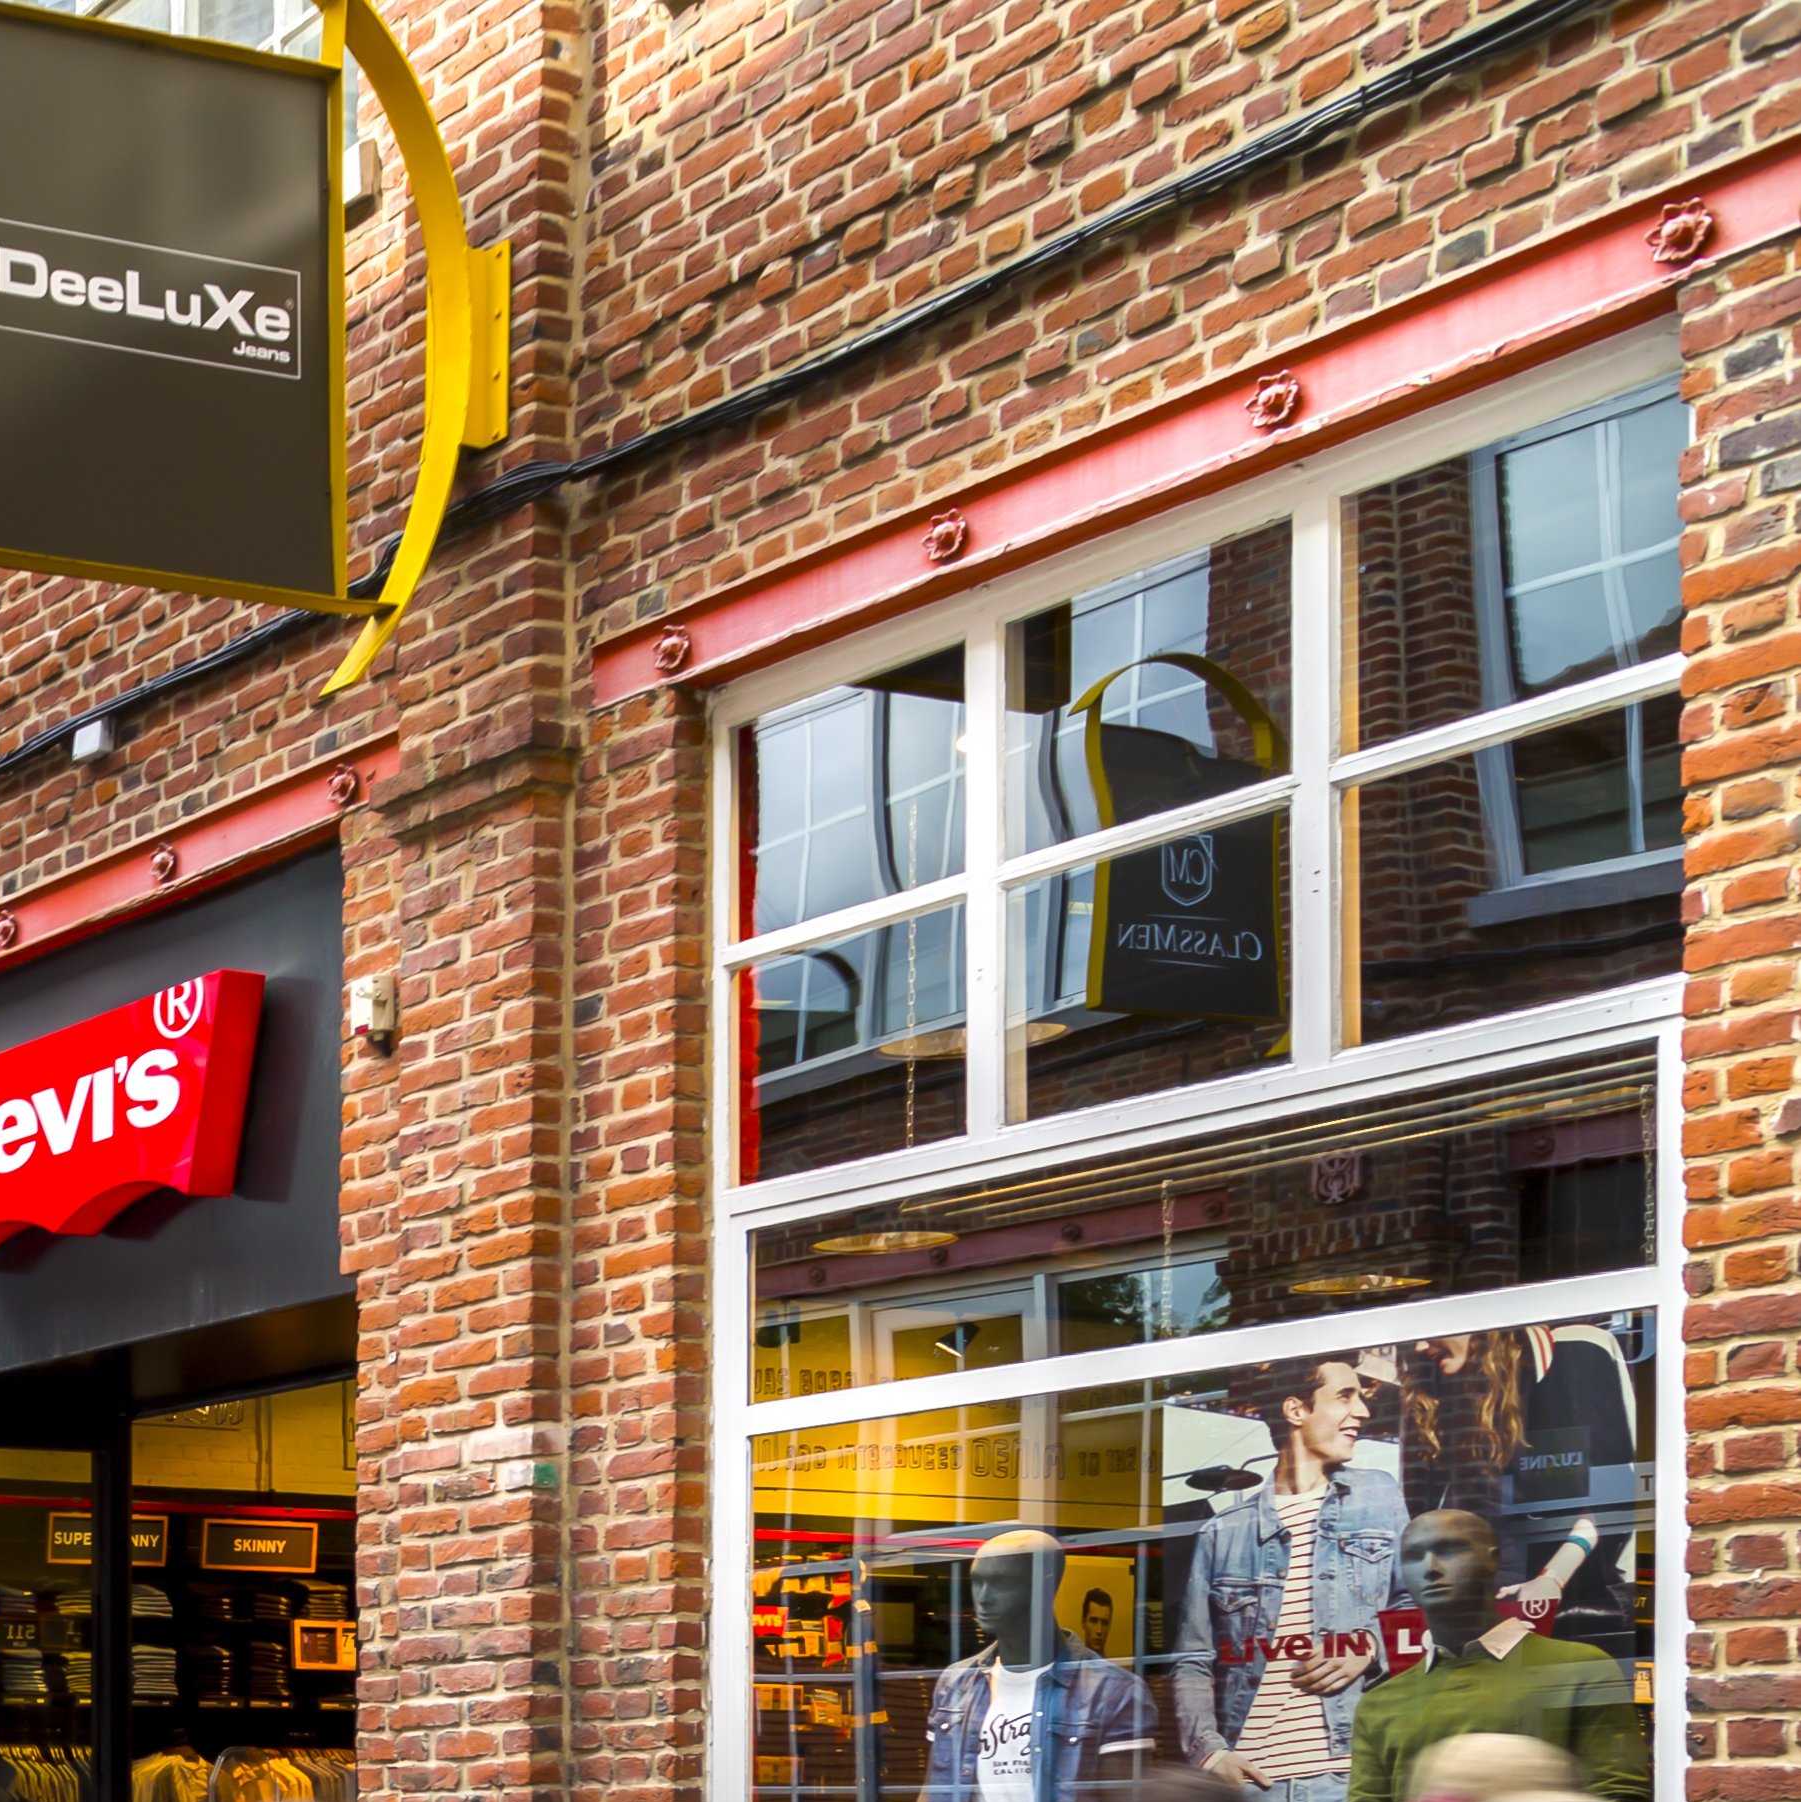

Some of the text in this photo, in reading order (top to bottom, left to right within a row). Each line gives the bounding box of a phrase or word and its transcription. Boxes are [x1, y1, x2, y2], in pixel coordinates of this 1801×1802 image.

[233, 341, 291, 363] Jeans
[53, 1532, 92, 1546] SUPE
[233, 1538, 287, 1554] SKINNY
[1323, 1630, 1370, 1658] IN
